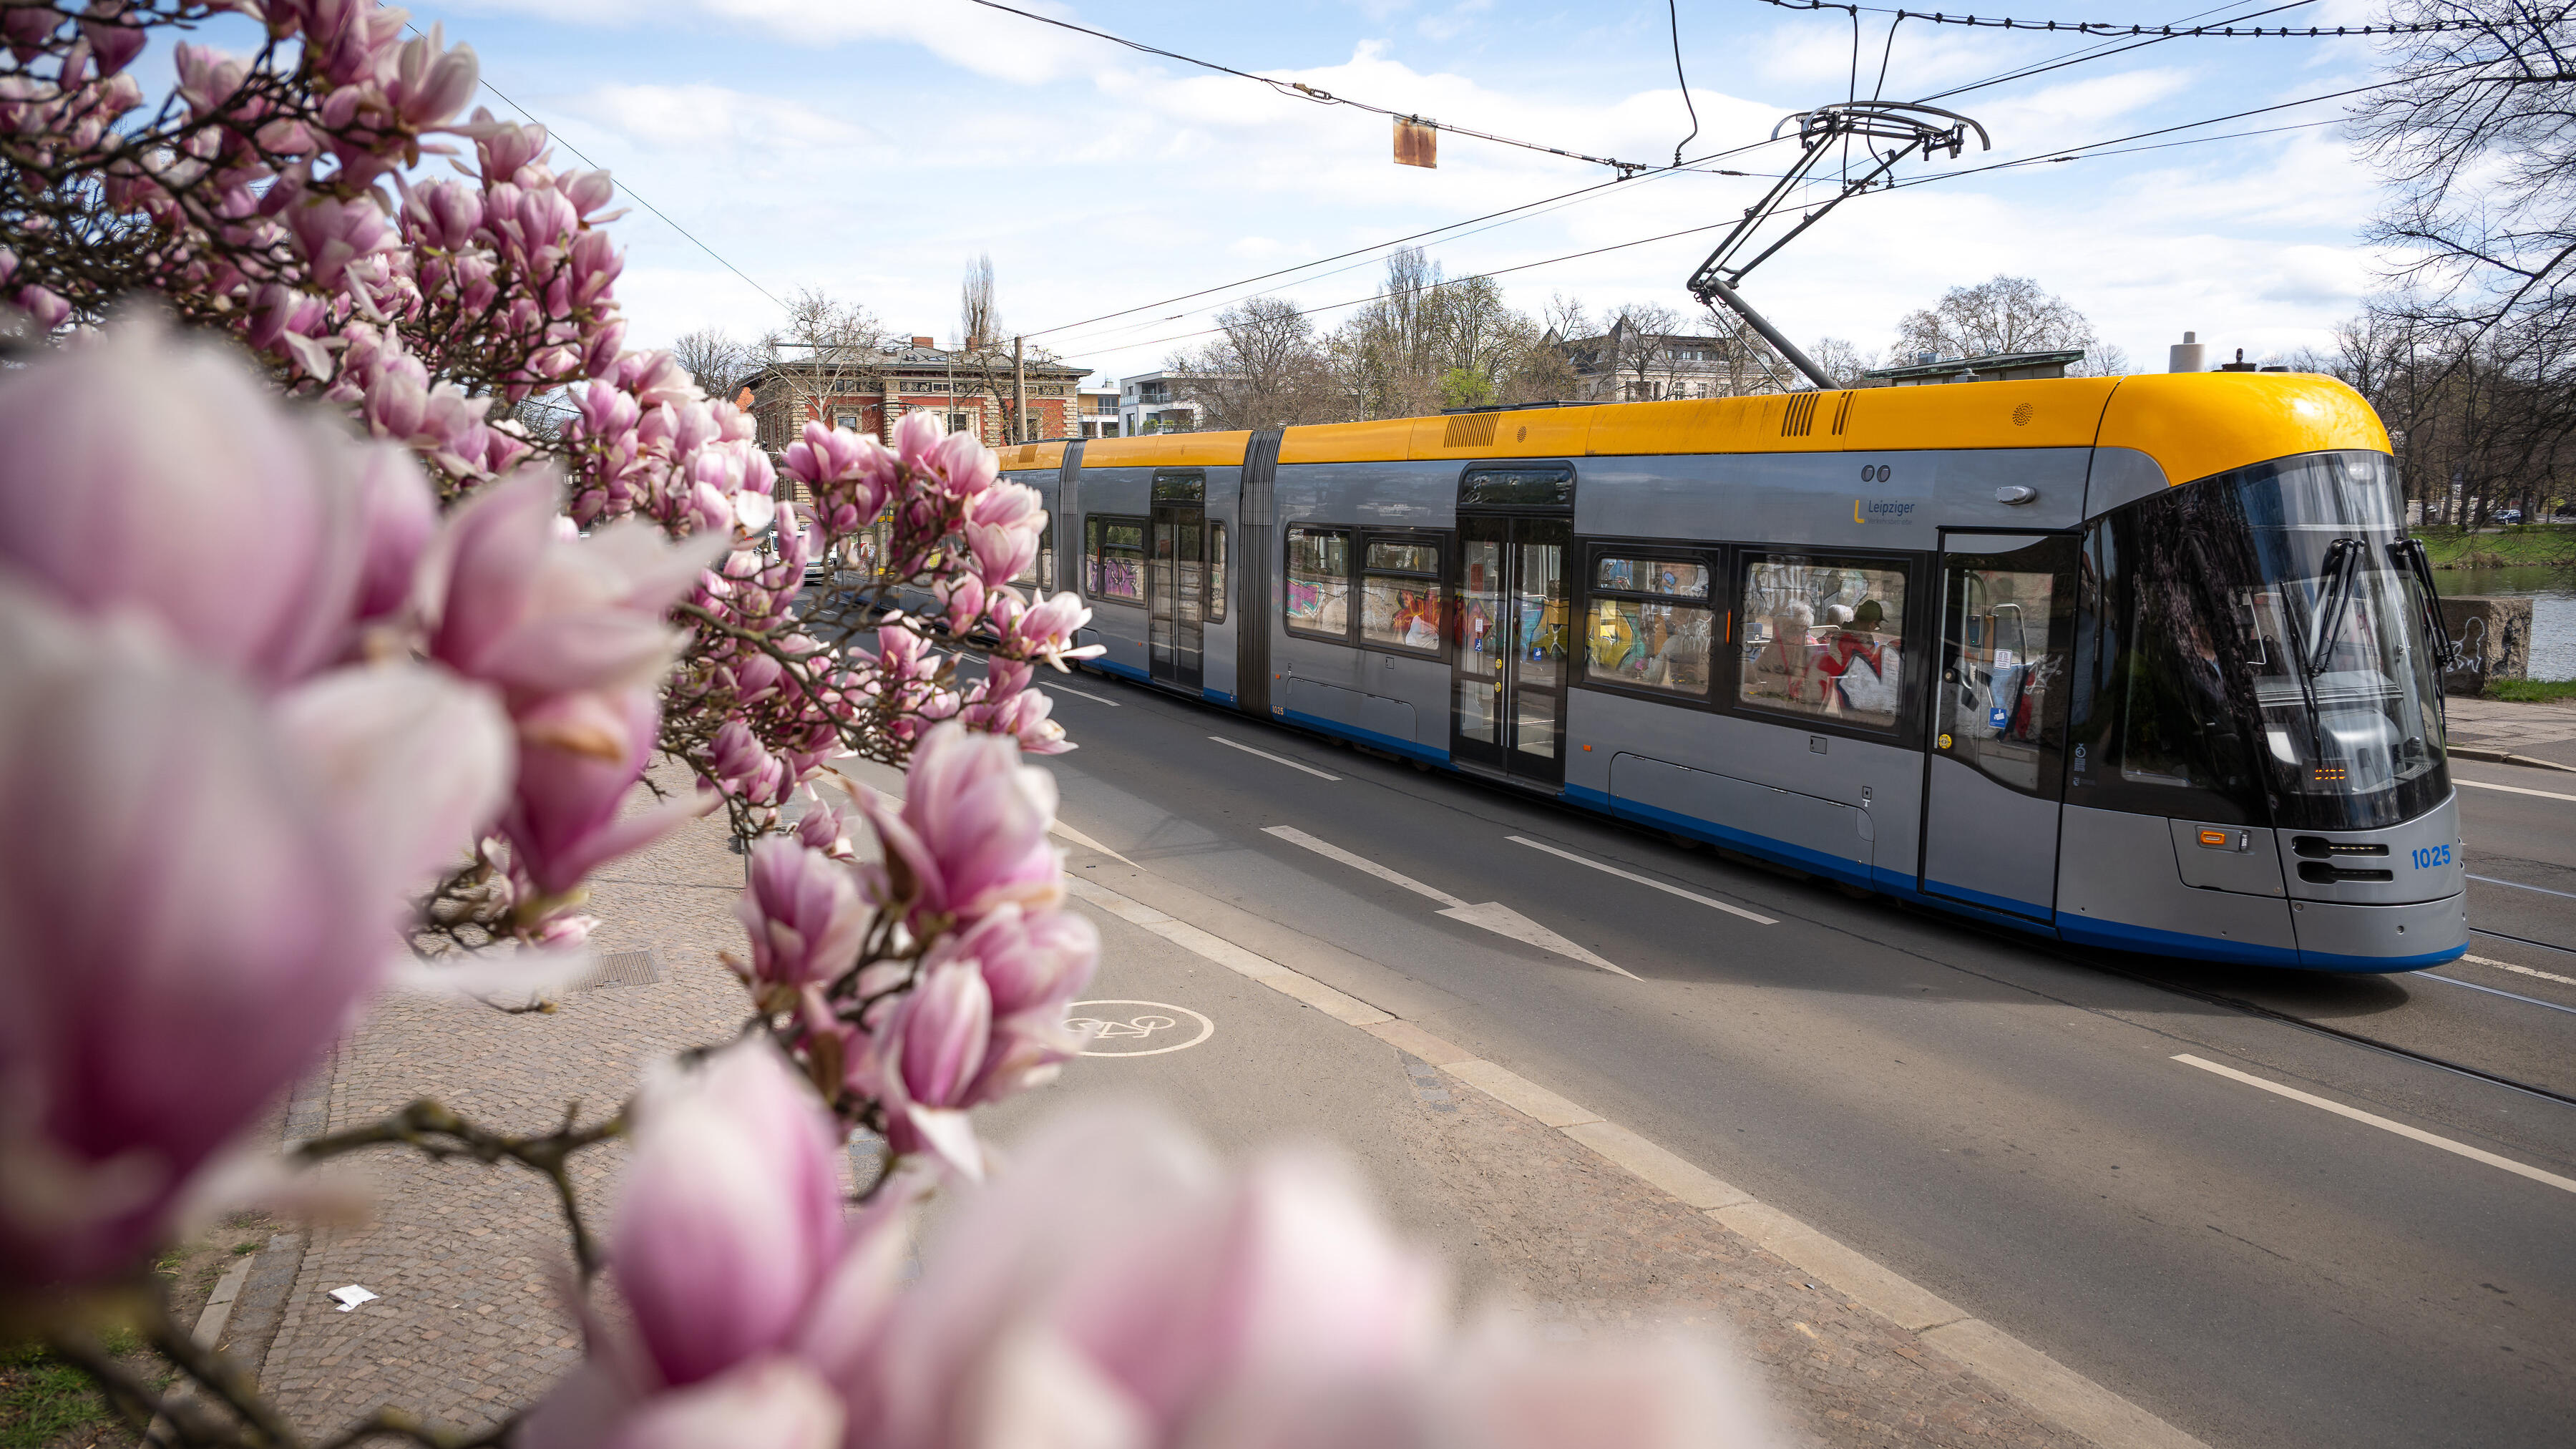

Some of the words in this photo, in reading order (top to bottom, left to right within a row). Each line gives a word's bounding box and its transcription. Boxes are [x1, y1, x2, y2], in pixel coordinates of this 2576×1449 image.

[1868, 499, 1916, 517] Leipziger
[1272, 705, 1284, 716] 1025
[2411, 844, 2451, 870] 1025
